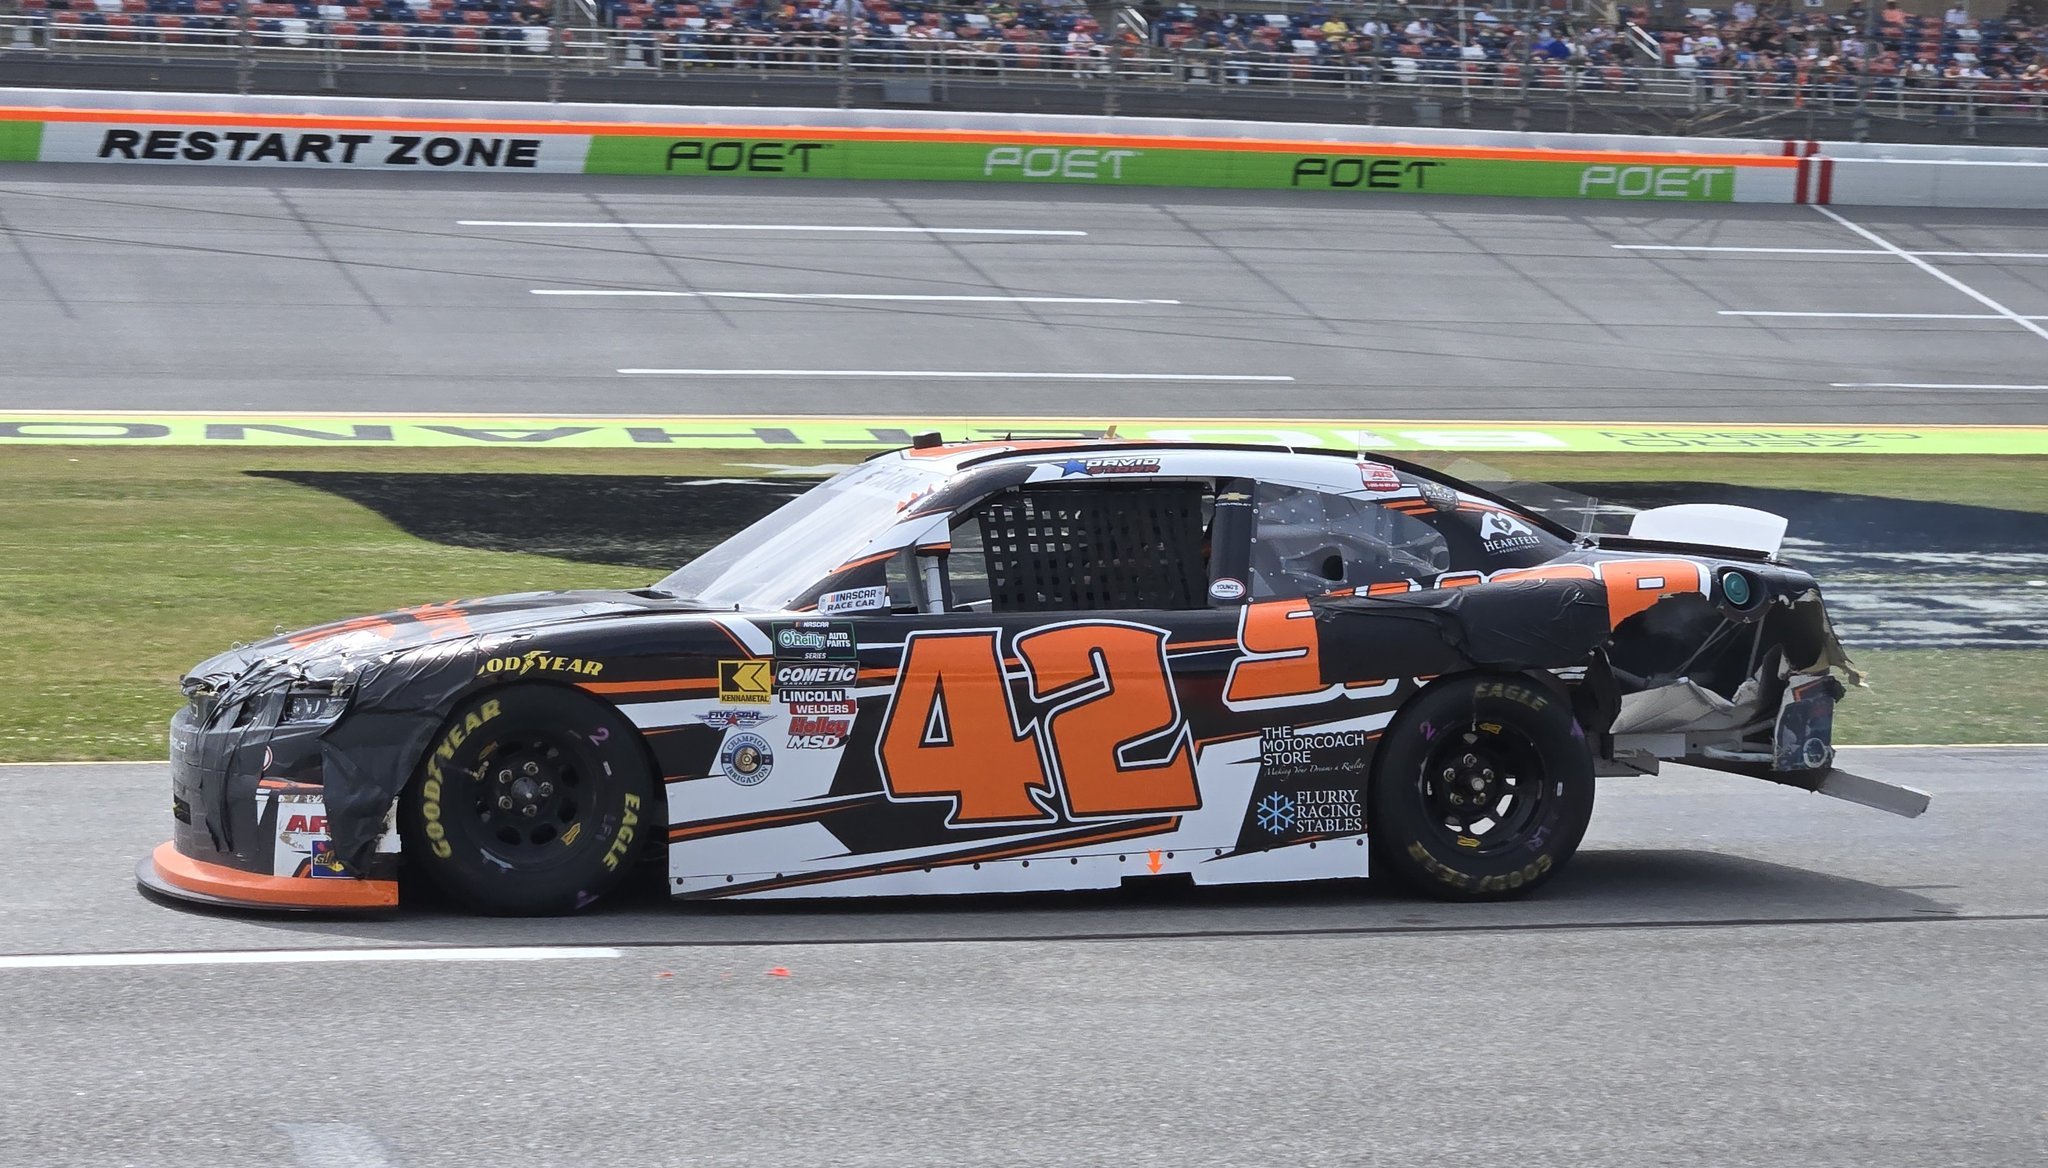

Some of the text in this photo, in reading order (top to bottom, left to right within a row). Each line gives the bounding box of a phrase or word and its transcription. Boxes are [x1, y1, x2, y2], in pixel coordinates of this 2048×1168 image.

[97, 129, 541, 168] RESTART ZONE
[666, 141, 826, 172] POET
[984, 146, 1136, 180] POET
[1292, 158, 1438, 188] POET
[1579, 165, 1730, 198] POET
[1086, 458, 1160, 467] DAVID
[1483, 536, 1540, 552] HEARTFELT
[840, 590, 876, 601] NASCAR
[827, 599, 875, 611] RACE CAR
[780, 630, 826, 650] O'Reilly
[827, 640, 851, 648] PARTS
[828, 632, 848, 640] AUTO
[804, 652, 827, 660] SERIES
[778, 667, 856, 682] COMETIC
[722, 694, 770, 703] KENNAMETAL
[782, 690, 842, 702] LINCOLN
[1475, 683, 1548, 711] EAGLE
[709, 711, 761, 719] FIVE STAR
[796, 704, 849, 714] WELDERS
[788, 717, 850, 737] Holley
[877, 619, 1202, 828] 42
[1262, 726, 1292, 739] THE
[727, 736, 767, 752] CHAMPION
[787, 735, 843, 749] MSD
[1262, 734, 1364, 753] MOTORCOACH
[1263, 751, 1311, 766] STORE
[423, 699, 502, 858] GOODYEAR
[726, 766, 768, 783] IRRIGATION
[1264, 766, 1293, 782] Making
[1296, 789, 1359, 805] FLURRY
[1296, 803, 1362, 819] RACING
[602, 793, 641, 872] EAGLE
[1296, 817, 1362, 833] STABLES
